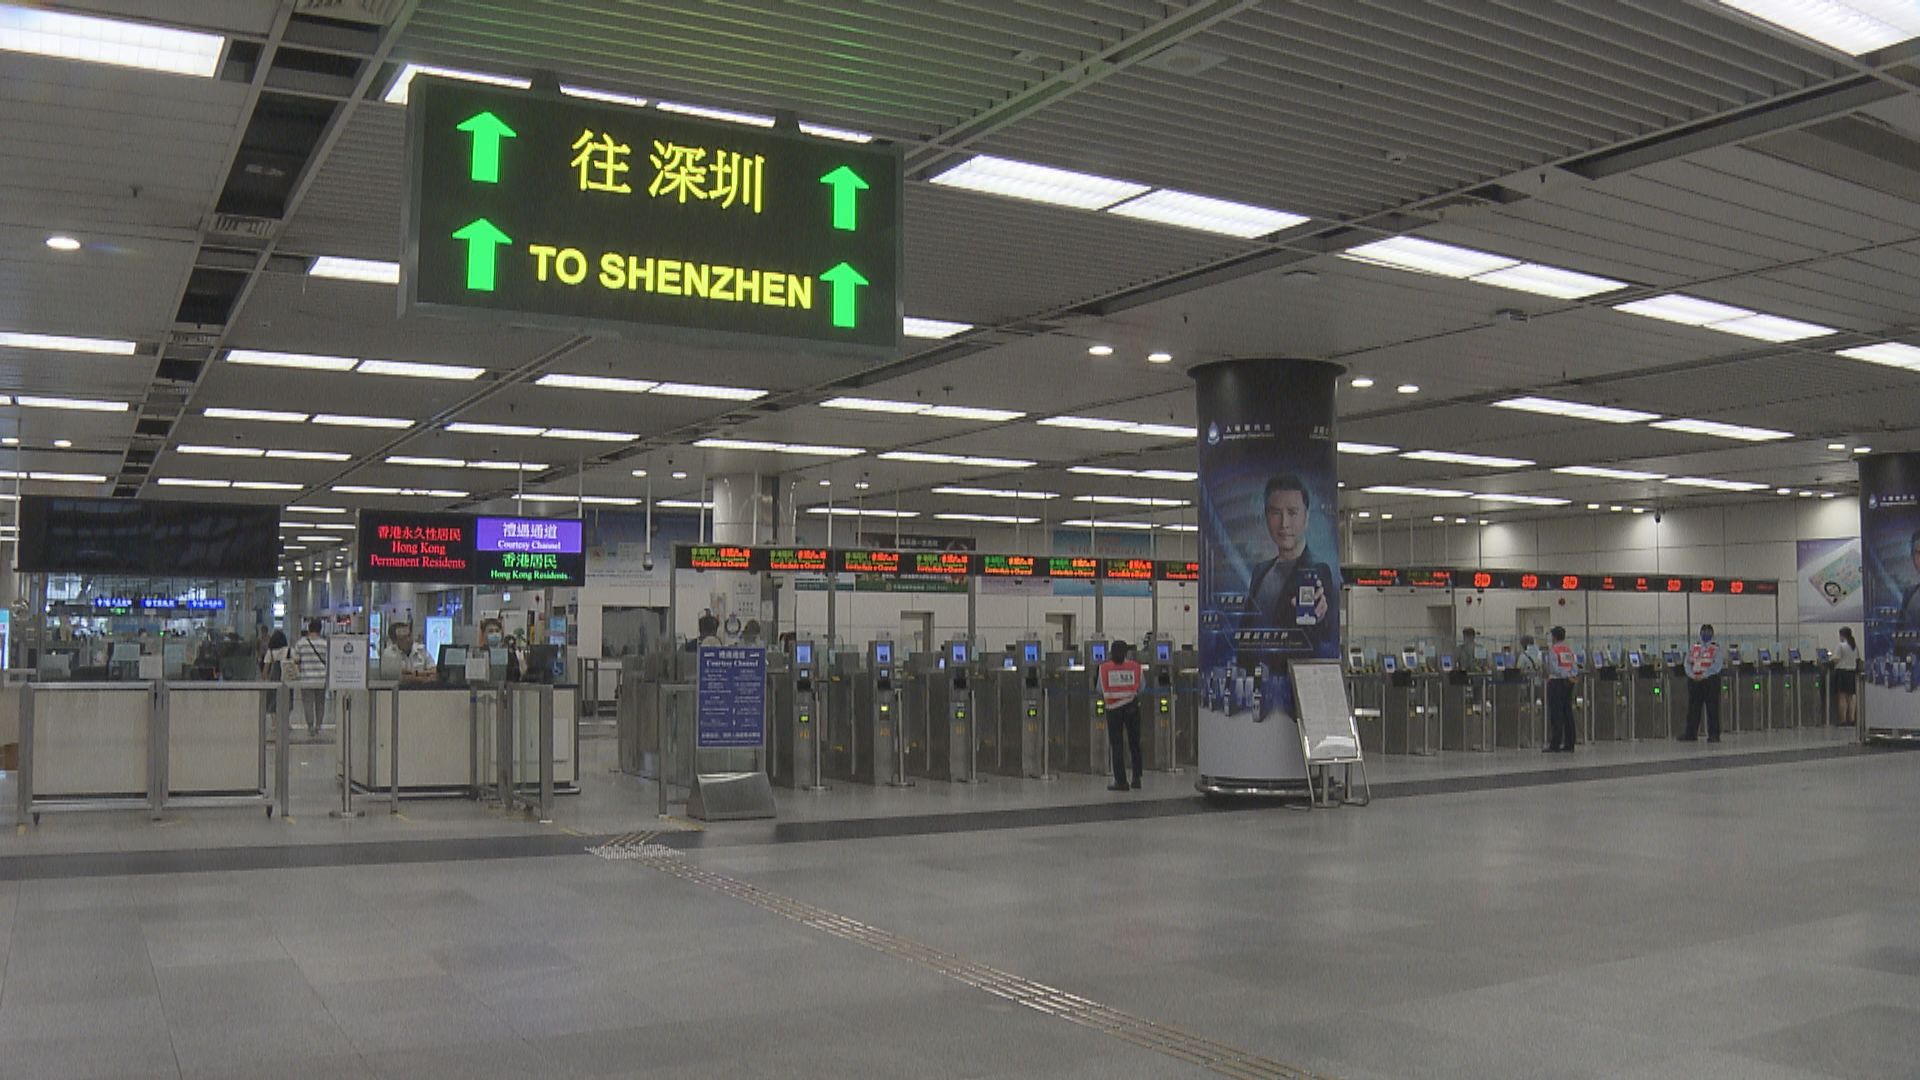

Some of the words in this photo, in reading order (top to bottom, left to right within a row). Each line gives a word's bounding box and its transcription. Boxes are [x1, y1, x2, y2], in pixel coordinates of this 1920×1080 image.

[571, 128, 632, 194] 往
[649, 139, 765, 214] 深圳
[529, 244, 588, 285] TO
[599, 252, 812, 310] SHENZHEN
[378, 525, 461, 541] 香港永久性居民
[503, 522, 558, 539] 禮遇通道
[392, 541, 418, 555] Hong
[420, 542, 446, 555] Kong
[497, 540, 530, 551] Courtesy
[532, 541, 561, 550] Channel
[370, 553, 419, 567] Permanent
[422, 556, 465, 569] Residents
[502, 552, 558, 569] 香港居民
[490, 570, 511, 580] Hong
[512, 570, 533, 581] Kong
[534, 571, 568, 580] Residents
